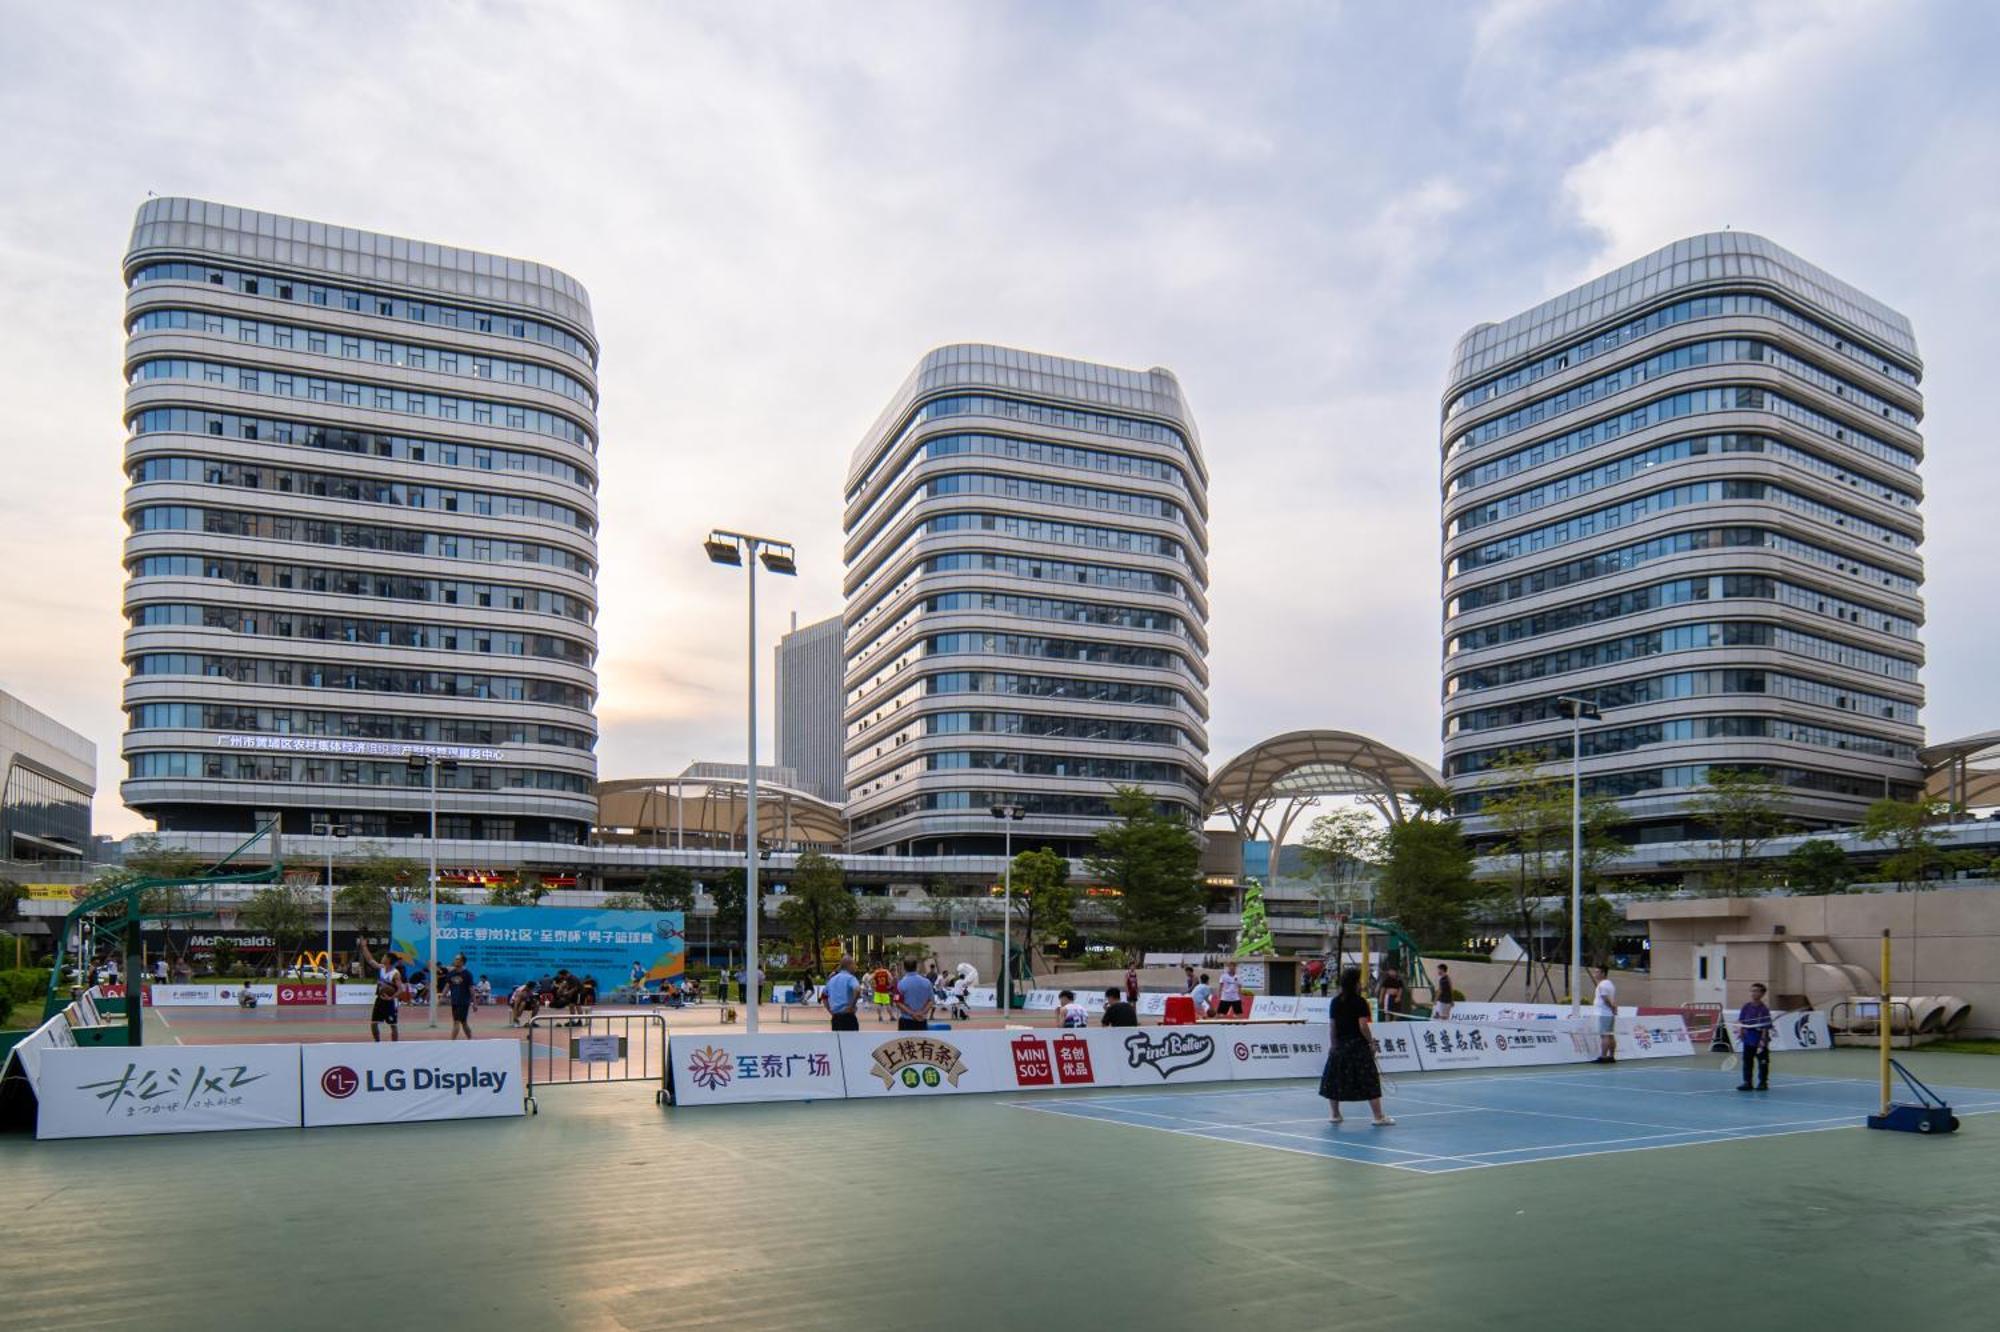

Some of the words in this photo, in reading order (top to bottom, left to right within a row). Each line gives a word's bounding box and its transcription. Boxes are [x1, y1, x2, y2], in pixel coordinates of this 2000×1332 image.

[883, 1040, 952, 1069] 上楼有条
[1016, 1048, 1046, 1061] MINI
[1061, 1047, 1086, 1060] 名创
[1126, 1034, 1170, 1066] Find
[1169, 1034, 1207, 1055] Better
[1251, 1043, 1288, 1054] 广州银行
[736, 1053, 831, 1079] 至泰广场
[1063, 1062, 1088, 1076] 优品
[366, 1069, 407, 1092] LG
[413, 1066, 508, 1095] Display
